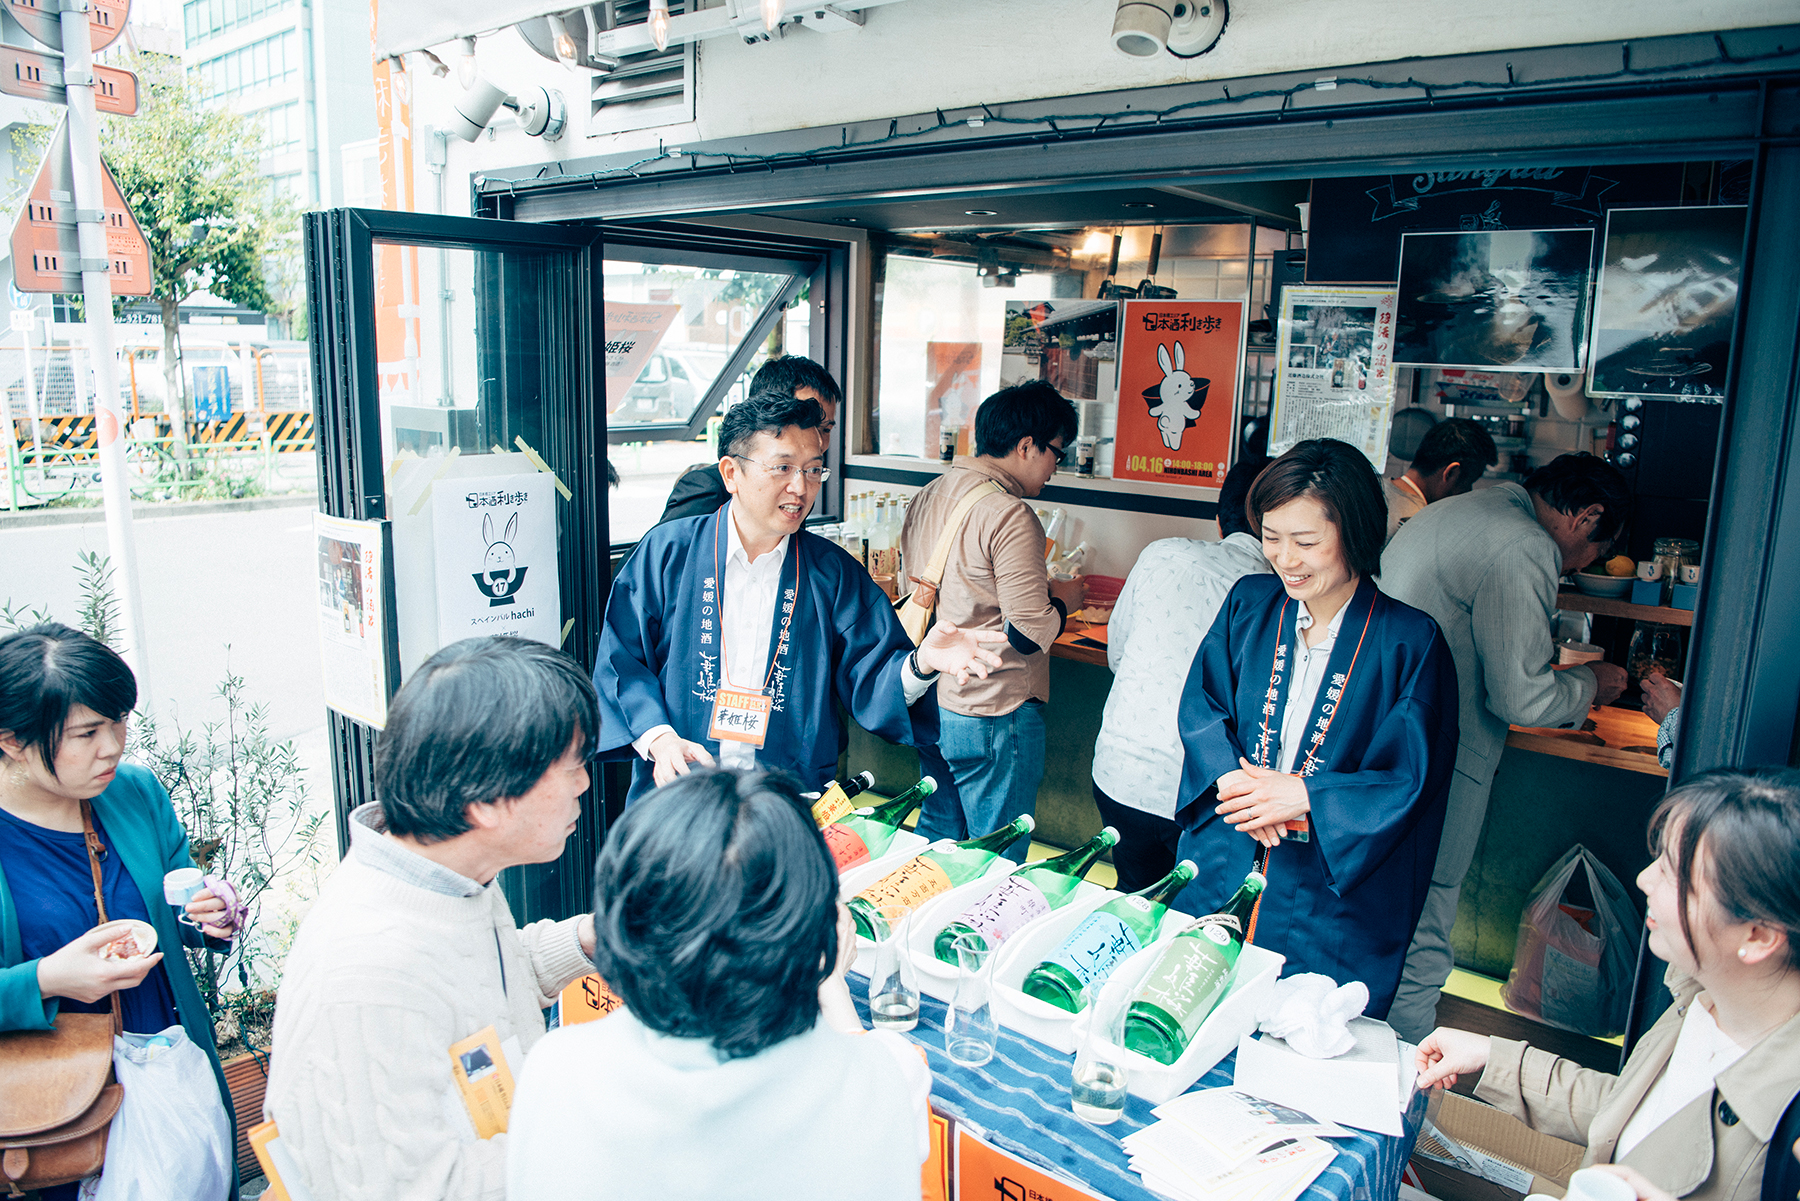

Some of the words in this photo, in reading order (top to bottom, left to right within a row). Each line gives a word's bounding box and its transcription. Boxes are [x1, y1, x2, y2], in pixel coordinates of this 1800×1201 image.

[1131, 455, 1163, 474] 04.16
[1164, 467, 1198, 476] NIHONBASHI
[1198, 470, 1213, 478] AREA
[495, 582, 506, 593] 17
[511, 607, 535, 620] hachi
[700, 577, 716, 645] 愛媛の地酒
[778, 588, 795, 656] 愛媛の地酒
[1262, 644, 1287, 717] 愛媛の地酒
[718, 692, 749, 709] STAFF
[1310, 672, 1346, 746] 愛媛の地酒
[717, 708, 759, 731] 華姫桜
[1208, 924, 1228, 944] 129
